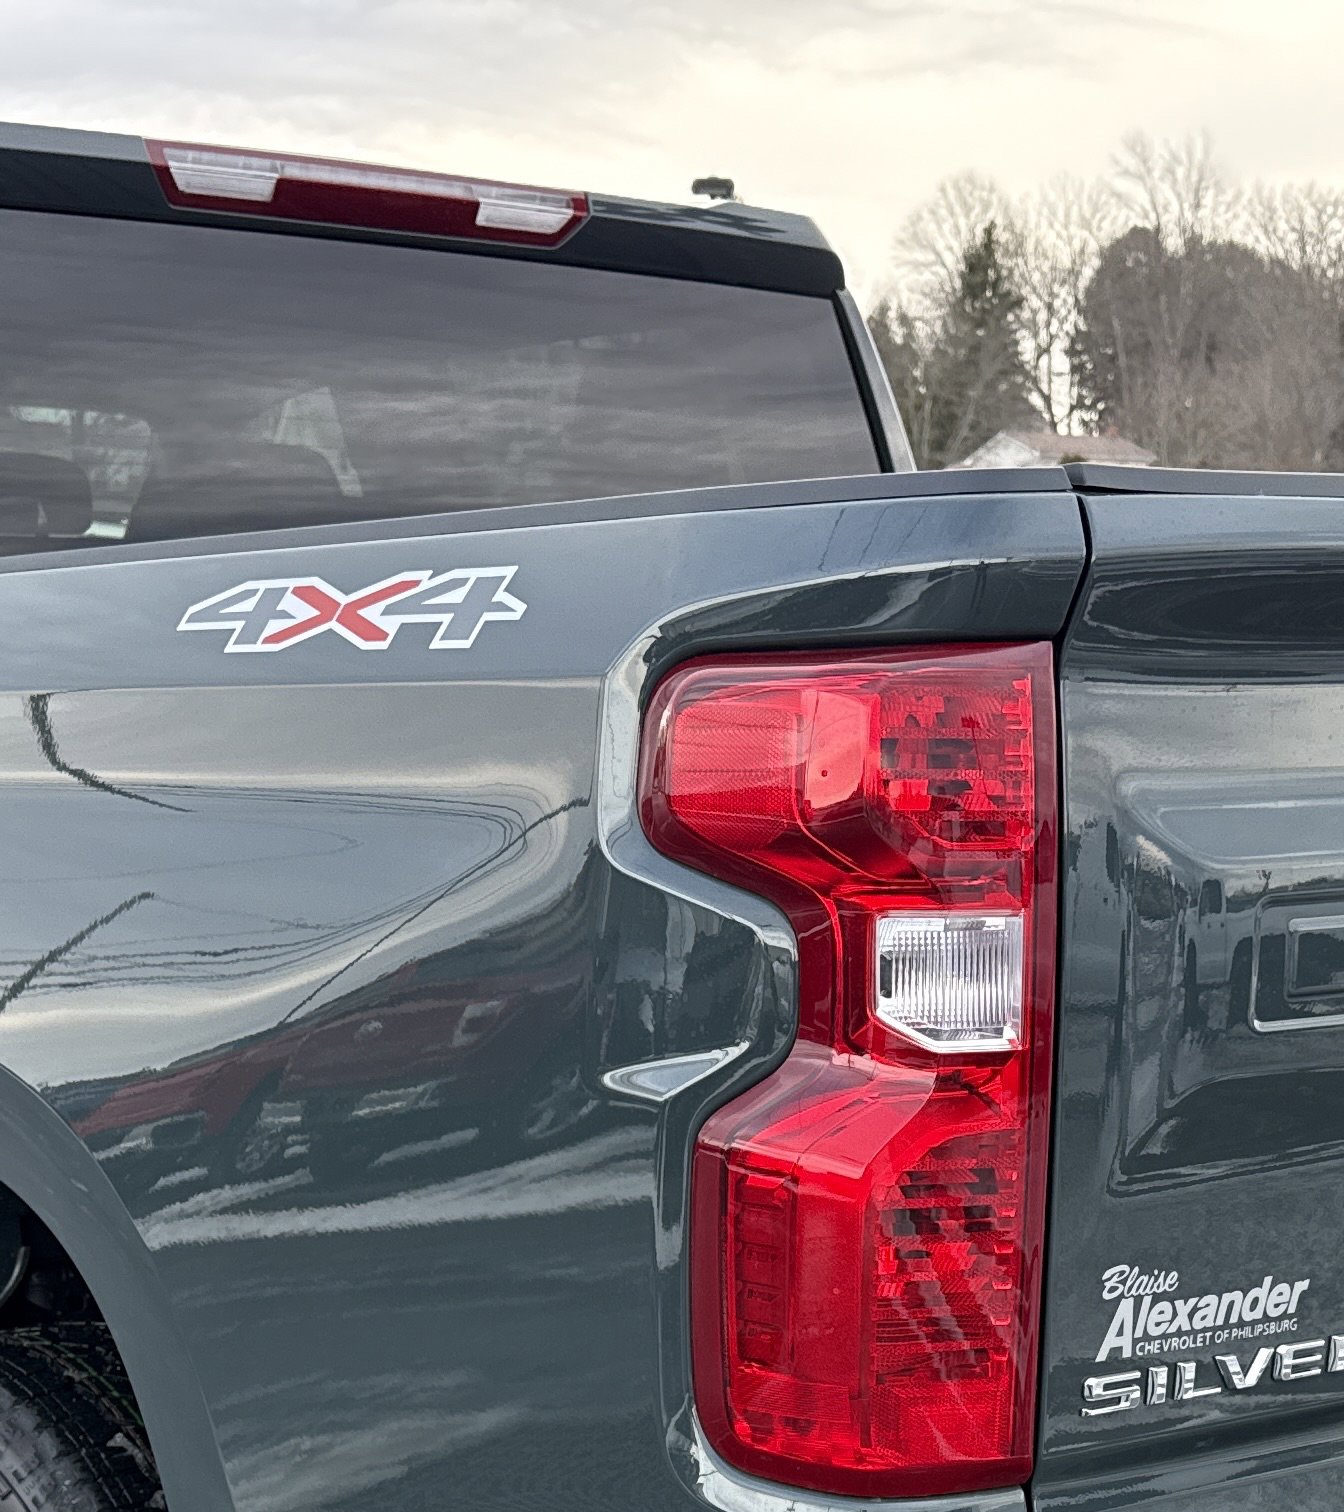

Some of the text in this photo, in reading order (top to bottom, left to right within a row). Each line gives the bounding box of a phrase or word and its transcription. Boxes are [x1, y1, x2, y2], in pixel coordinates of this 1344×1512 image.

[1102, 1264, 1179, 1300] Blaise
[1095, 1275, 1310, 1363] Alexander
[1135, 1318, 1298, 1356] CHEVROLET OF PHILIPSBURG
